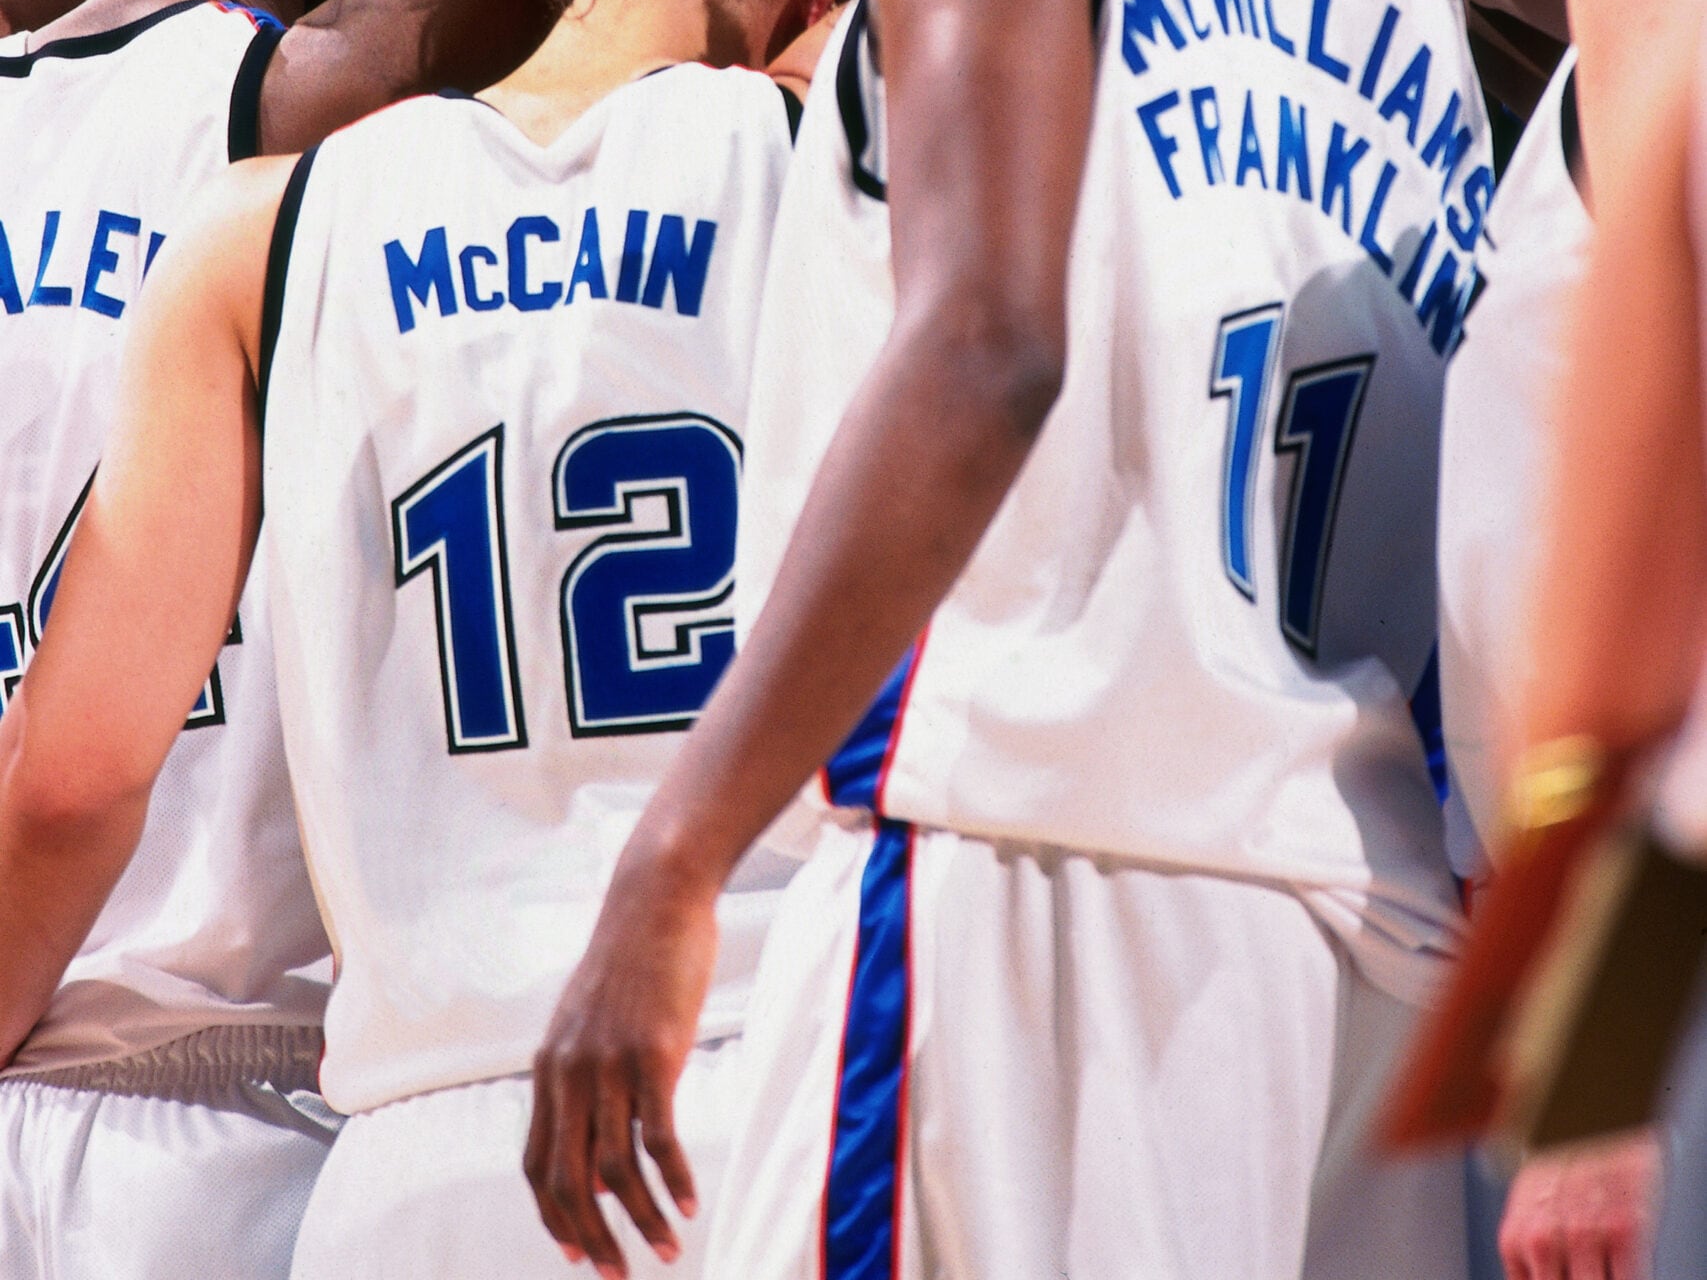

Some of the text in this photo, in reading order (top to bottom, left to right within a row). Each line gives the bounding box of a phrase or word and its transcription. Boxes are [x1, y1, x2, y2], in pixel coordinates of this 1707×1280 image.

[384, 207, 717, 334] McCAIN
[1136, 86, 1488, 357] FRANKLIN
[392, 412, 744, 754] 12
[1210, 302, 1378, 660] 11
